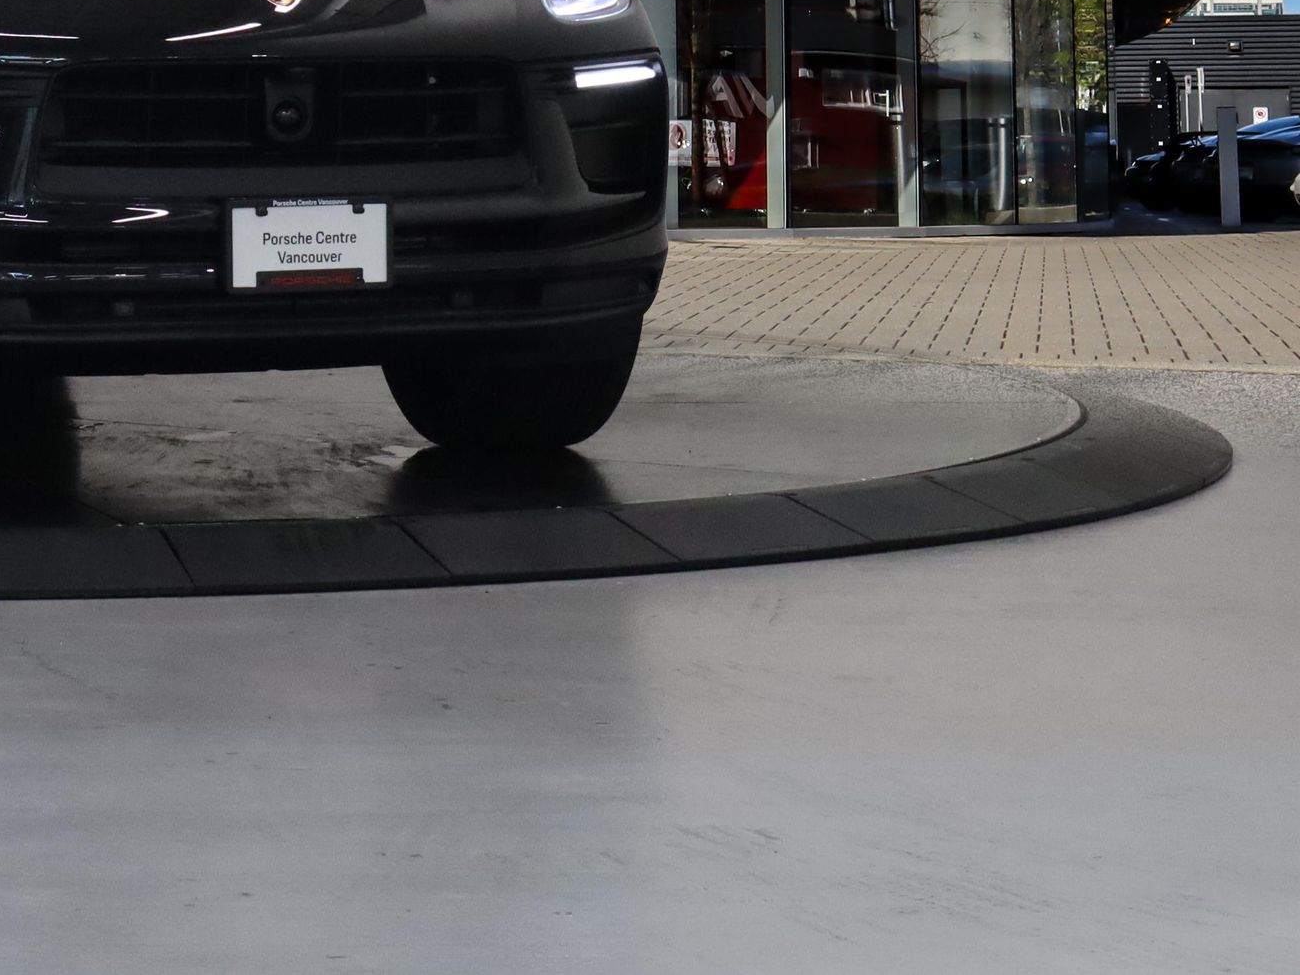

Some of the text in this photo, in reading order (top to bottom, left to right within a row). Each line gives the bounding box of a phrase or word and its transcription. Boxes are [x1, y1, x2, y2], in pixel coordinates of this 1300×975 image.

[272, 199, 297, 207] Porsche
[262, 231, 357, 245] Porsche Centre
[277, 251, 343, 264] Vancouver
